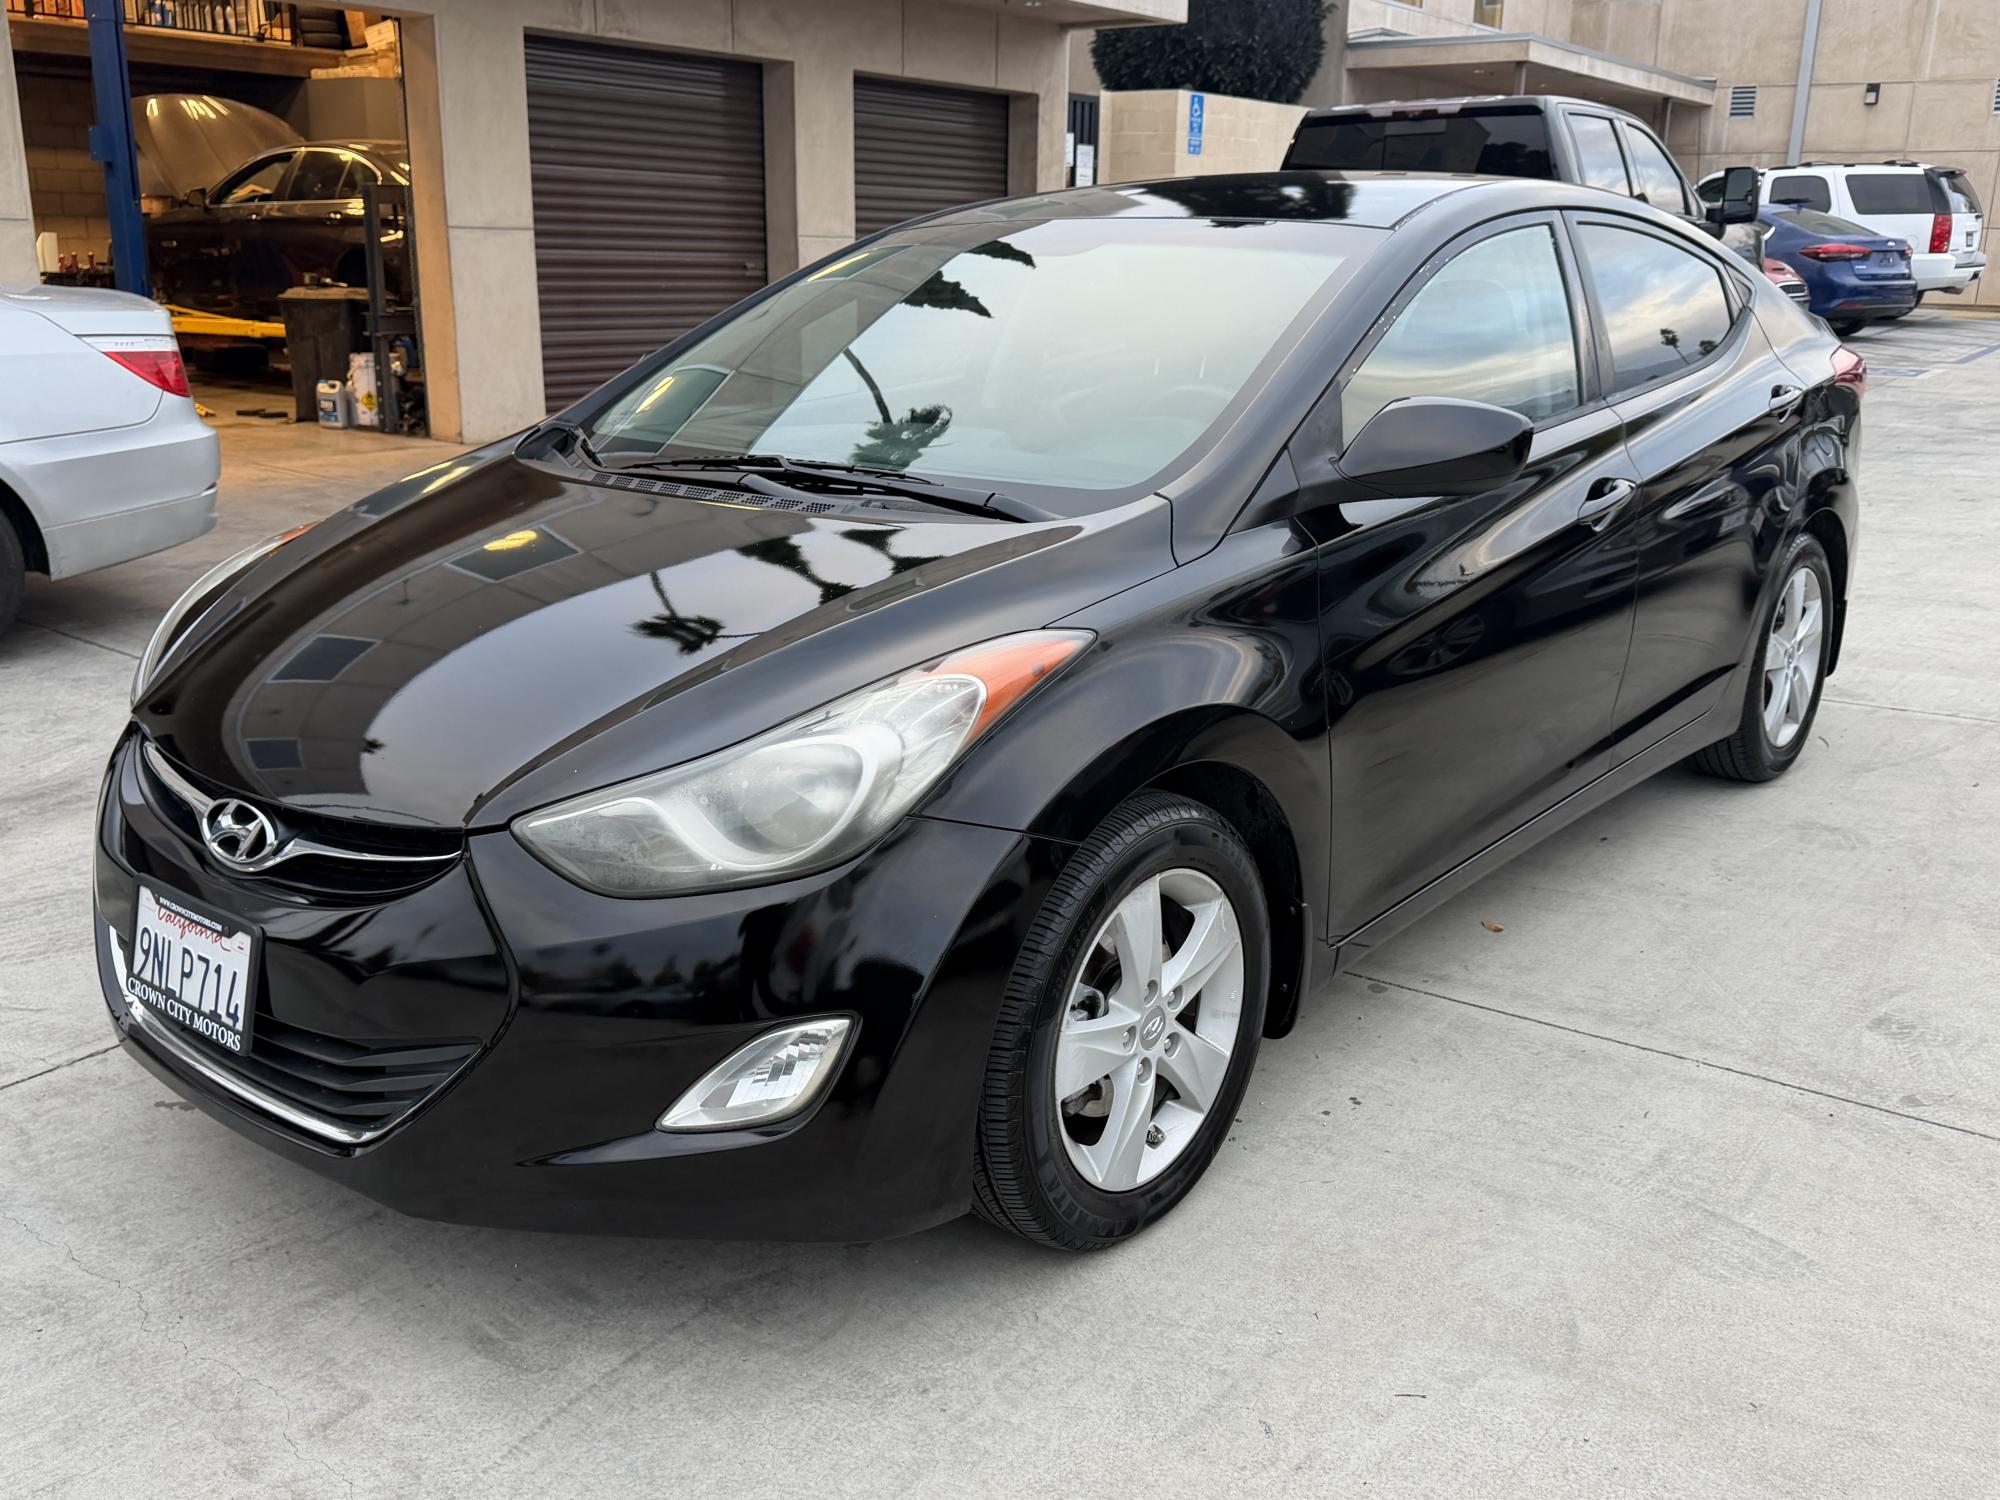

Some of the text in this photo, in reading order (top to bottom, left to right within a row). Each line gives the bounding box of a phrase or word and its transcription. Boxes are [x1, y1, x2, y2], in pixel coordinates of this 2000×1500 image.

[128, 976, 241, 1051] CROWN CITY MOTORS
[137, 926, 240, 1028] 9NLP714
